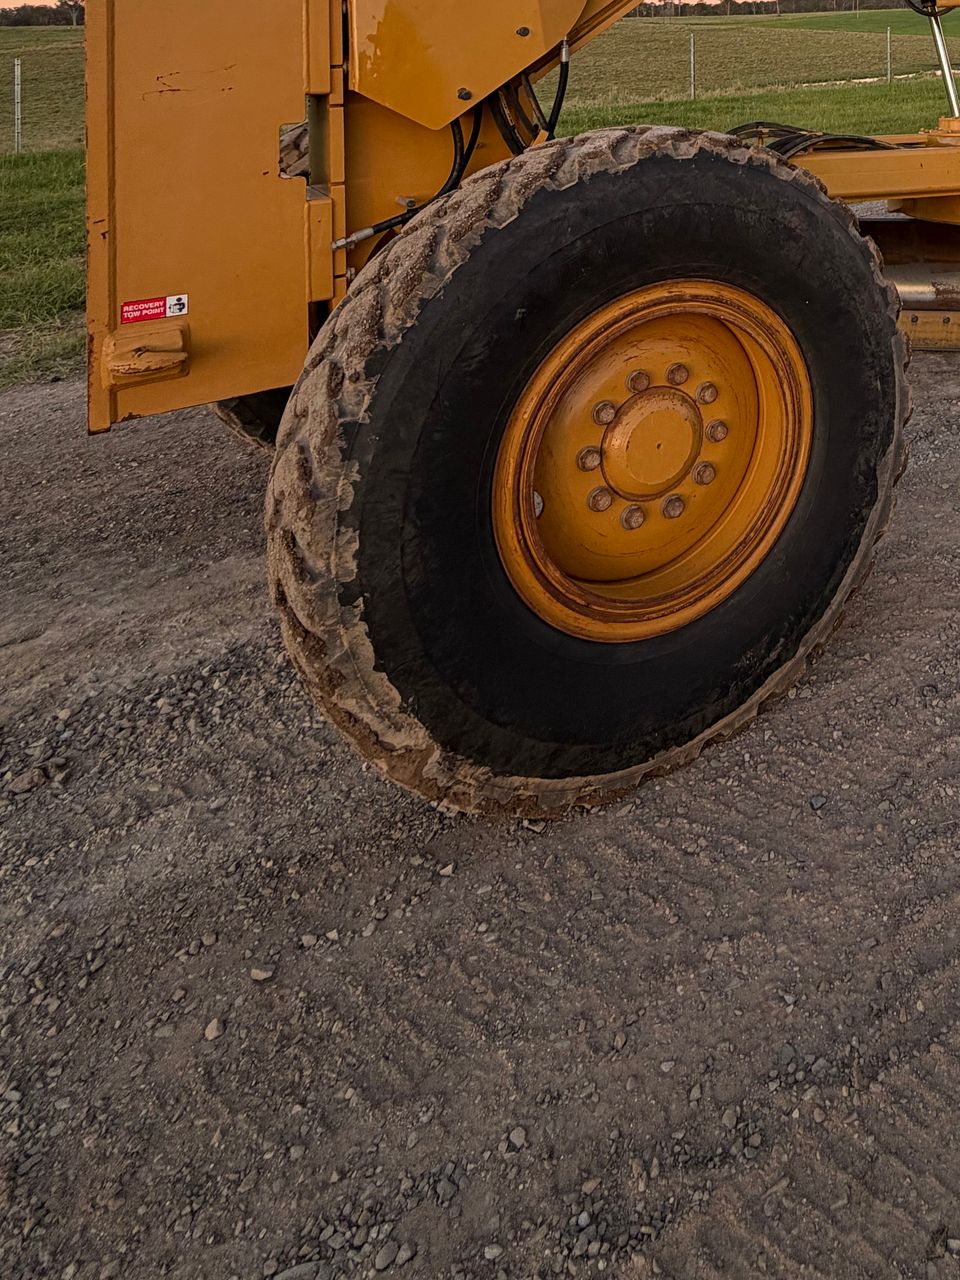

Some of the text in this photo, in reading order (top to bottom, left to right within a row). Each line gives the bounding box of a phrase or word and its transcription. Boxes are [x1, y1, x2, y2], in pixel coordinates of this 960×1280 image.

[123, 301, 165, 312] RECOVERY
[123, 307, 165, 319] TOW POINT
